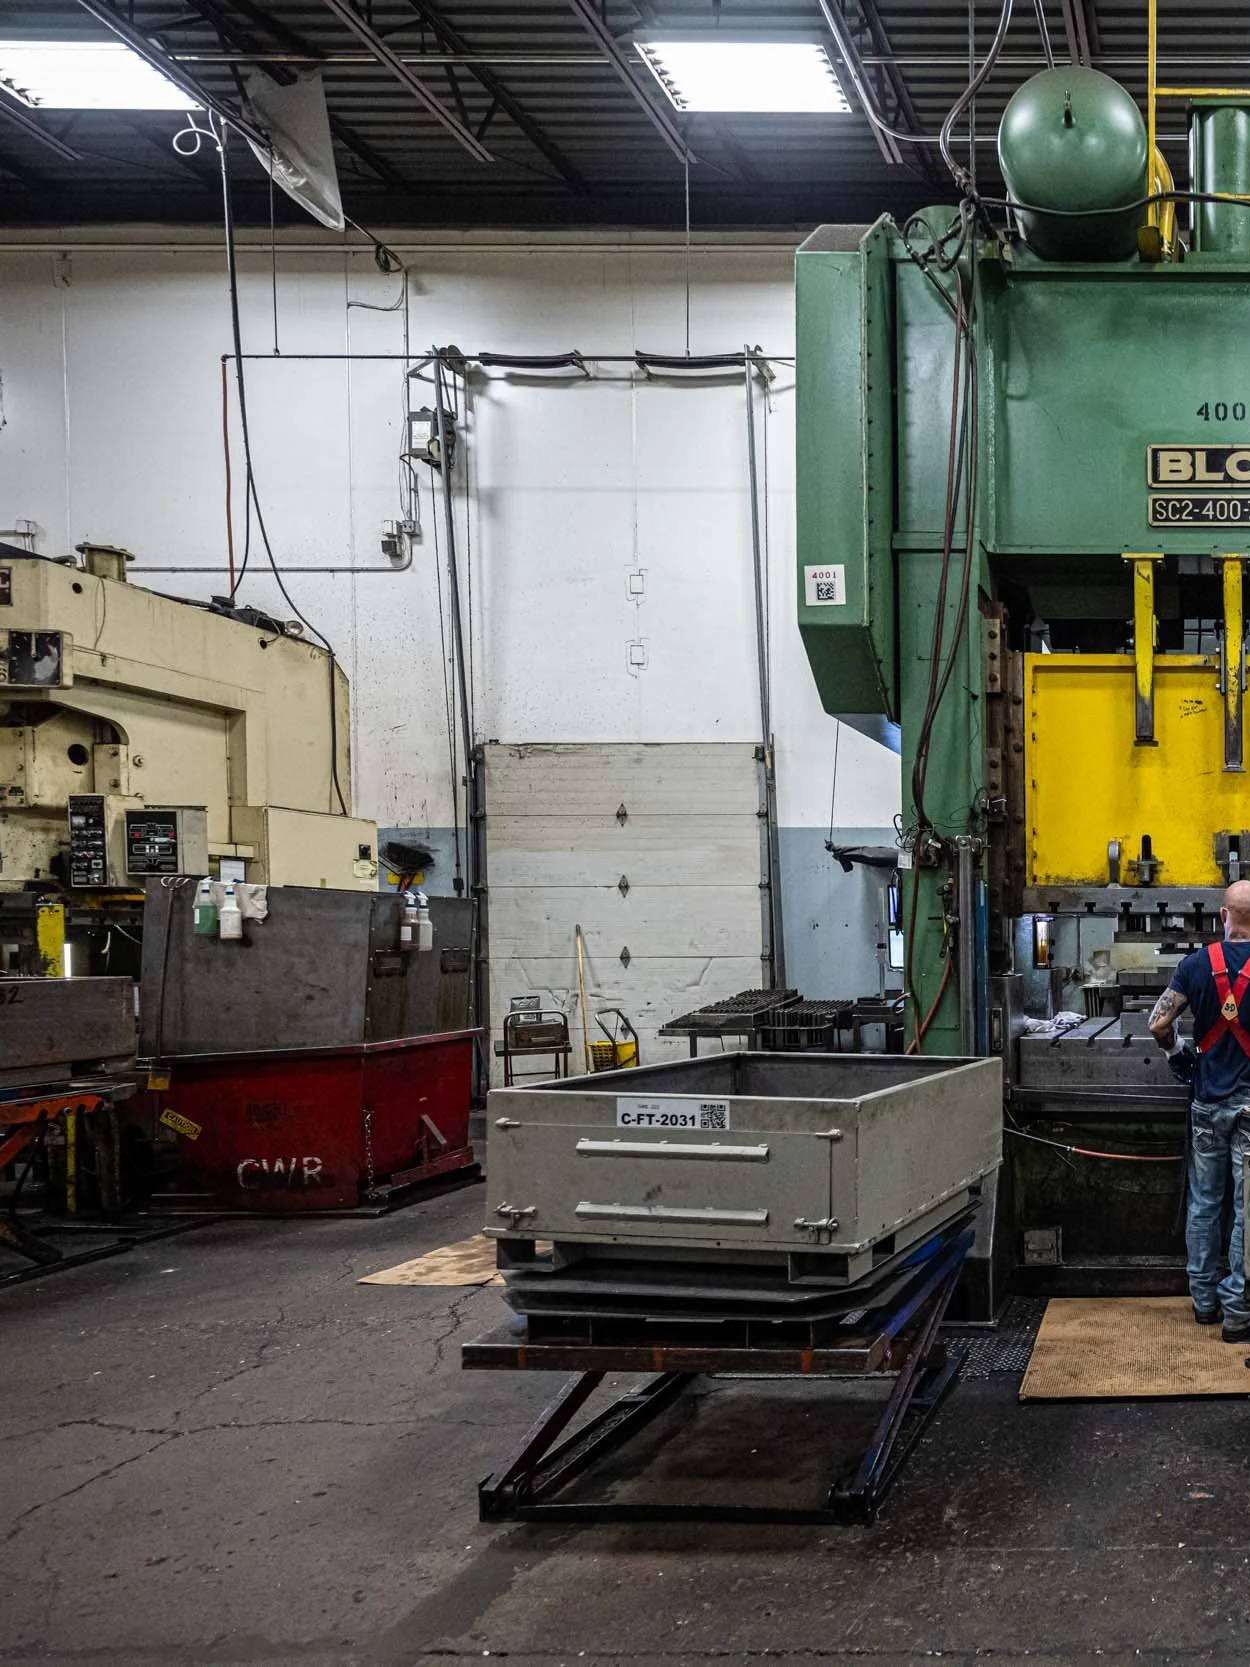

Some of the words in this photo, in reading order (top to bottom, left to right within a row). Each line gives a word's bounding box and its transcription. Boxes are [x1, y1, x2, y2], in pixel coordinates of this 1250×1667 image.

[811, 571, 837, 579] 4001
[166, 1112, 199, 1134] CAUTION
[621, 1112, 697, 1127] C-FT-2031
[237, 1156, 323, 1189] CWR
